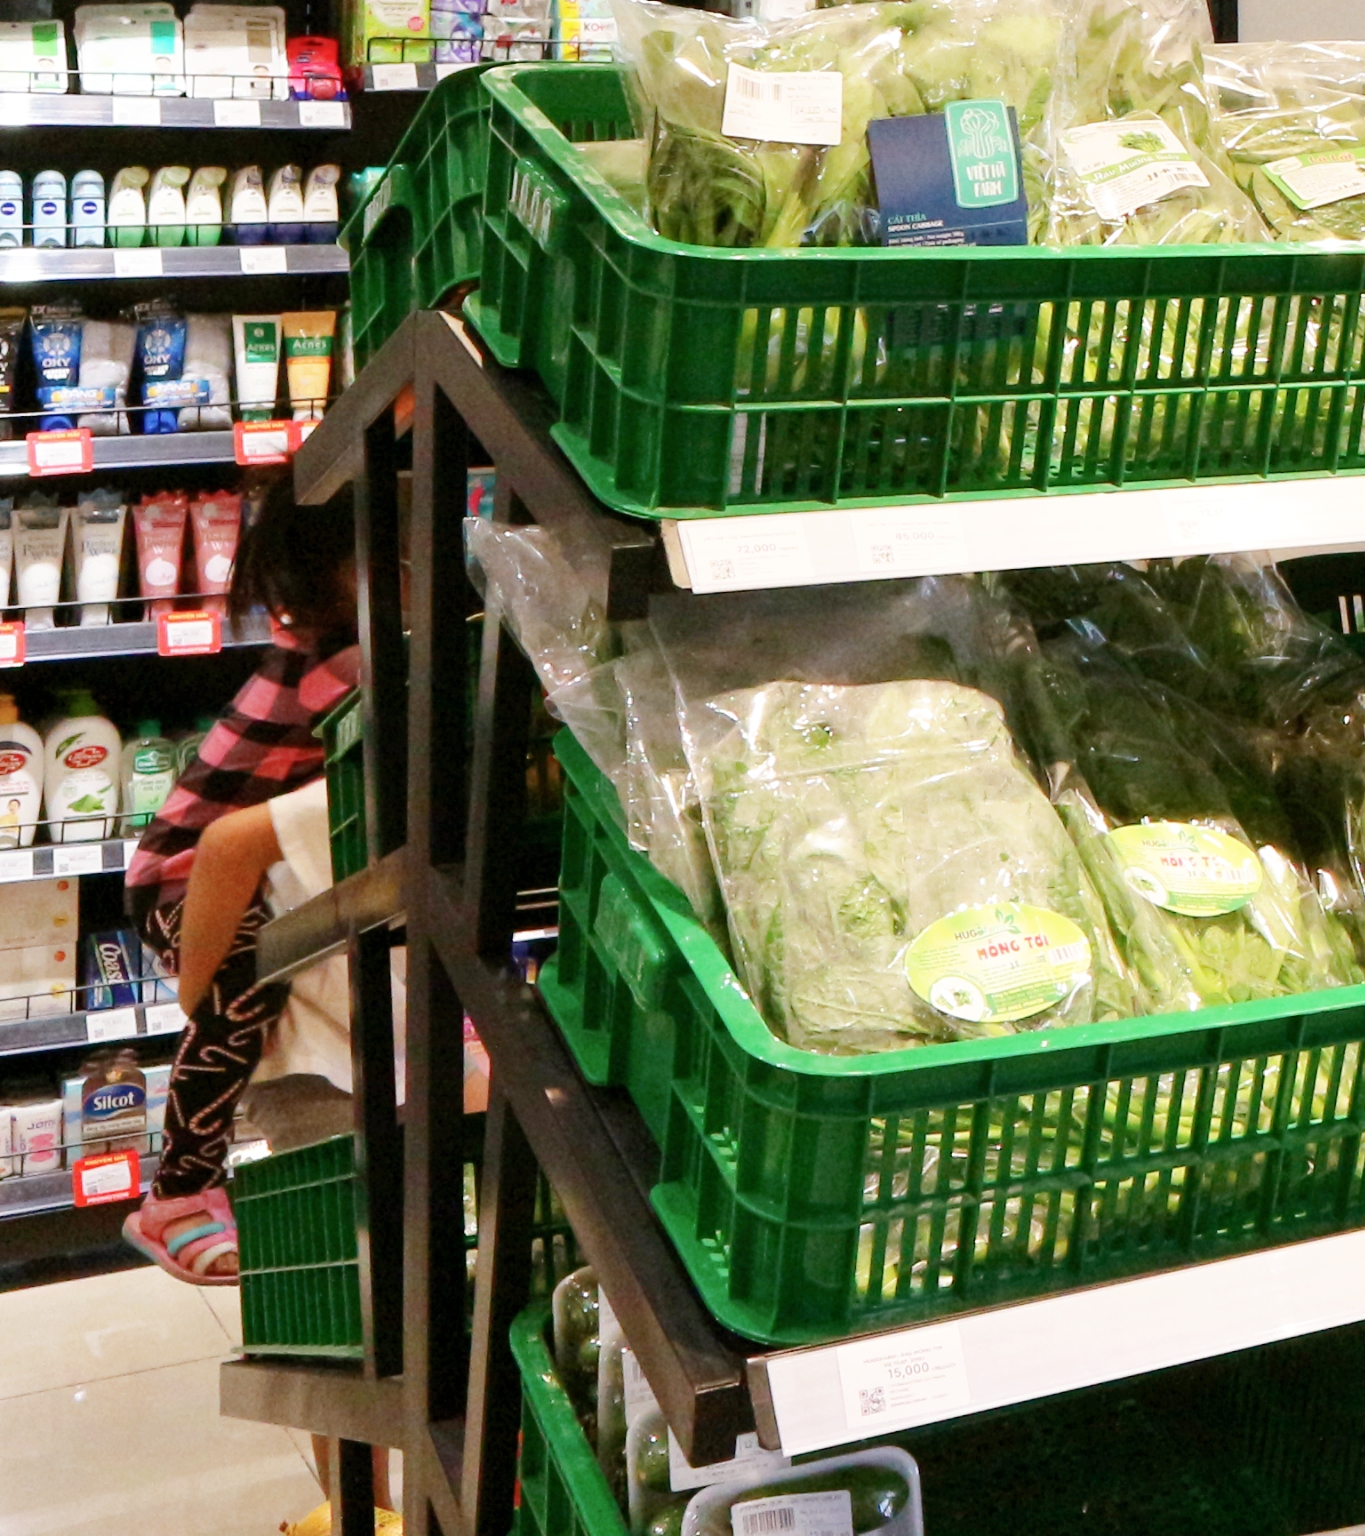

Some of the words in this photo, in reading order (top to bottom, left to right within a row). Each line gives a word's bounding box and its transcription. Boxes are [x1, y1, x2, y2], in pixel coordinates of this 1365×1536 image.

[966, 162, 990, 182] VIỆT
[973, 181, 1002, 197] FARM
[292, 337, 327, 350] Acnes
[41, 356, 71, 369] OXY
[93, 1092, 134, 1110] Silcot
[888, 1362, 929, 1379] 15,000
